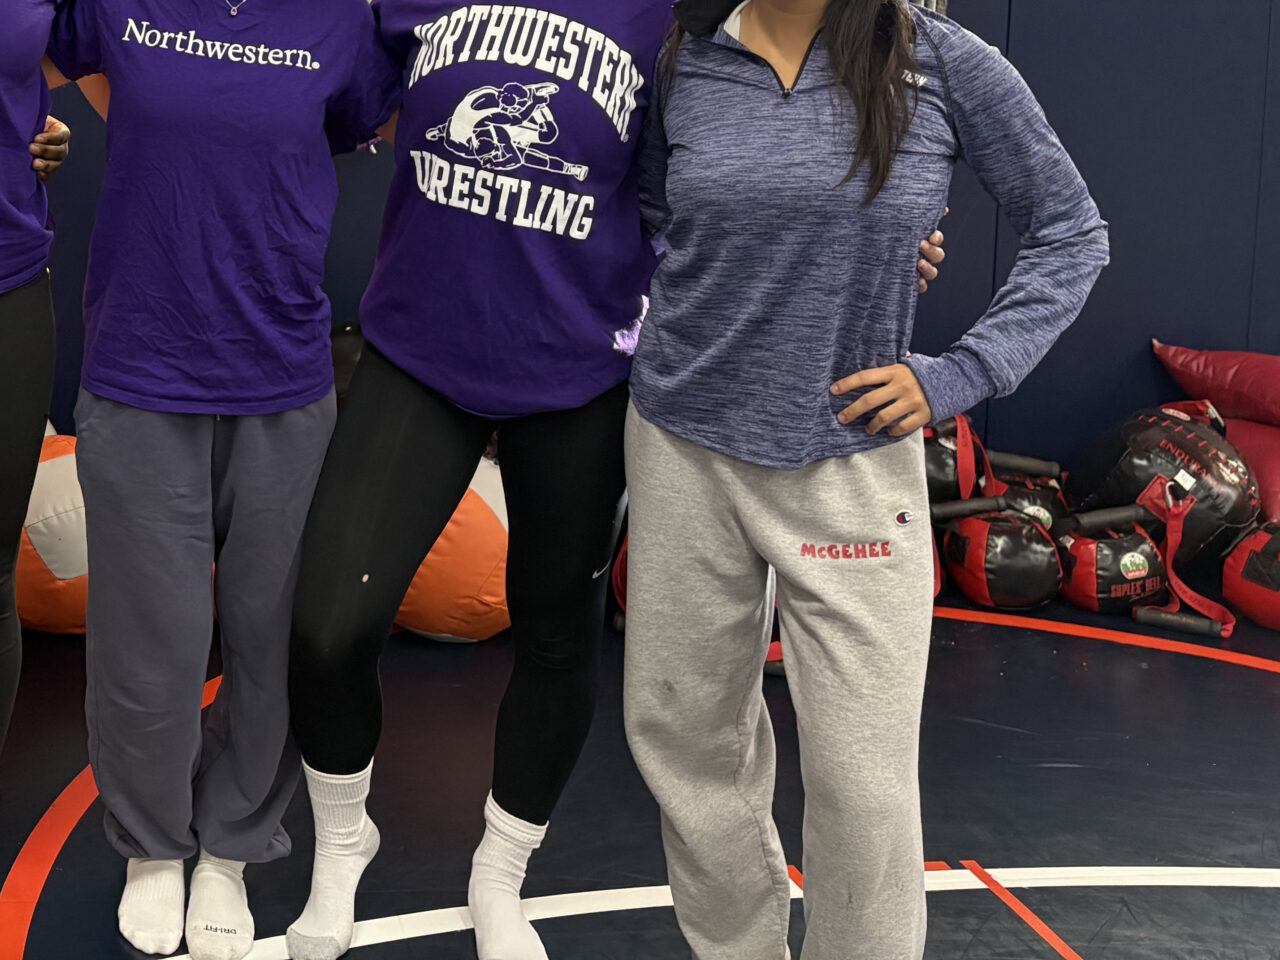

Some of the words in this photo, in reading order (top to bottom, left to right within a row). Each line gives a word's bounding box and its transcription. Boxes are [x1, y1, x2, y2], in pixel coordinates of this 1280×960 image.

[408, 4, 645, 142] NORTHWESTERN
[800, 541, 892, 559] McGEHEE
[203, 924, 237, 934] DRI-FIT
